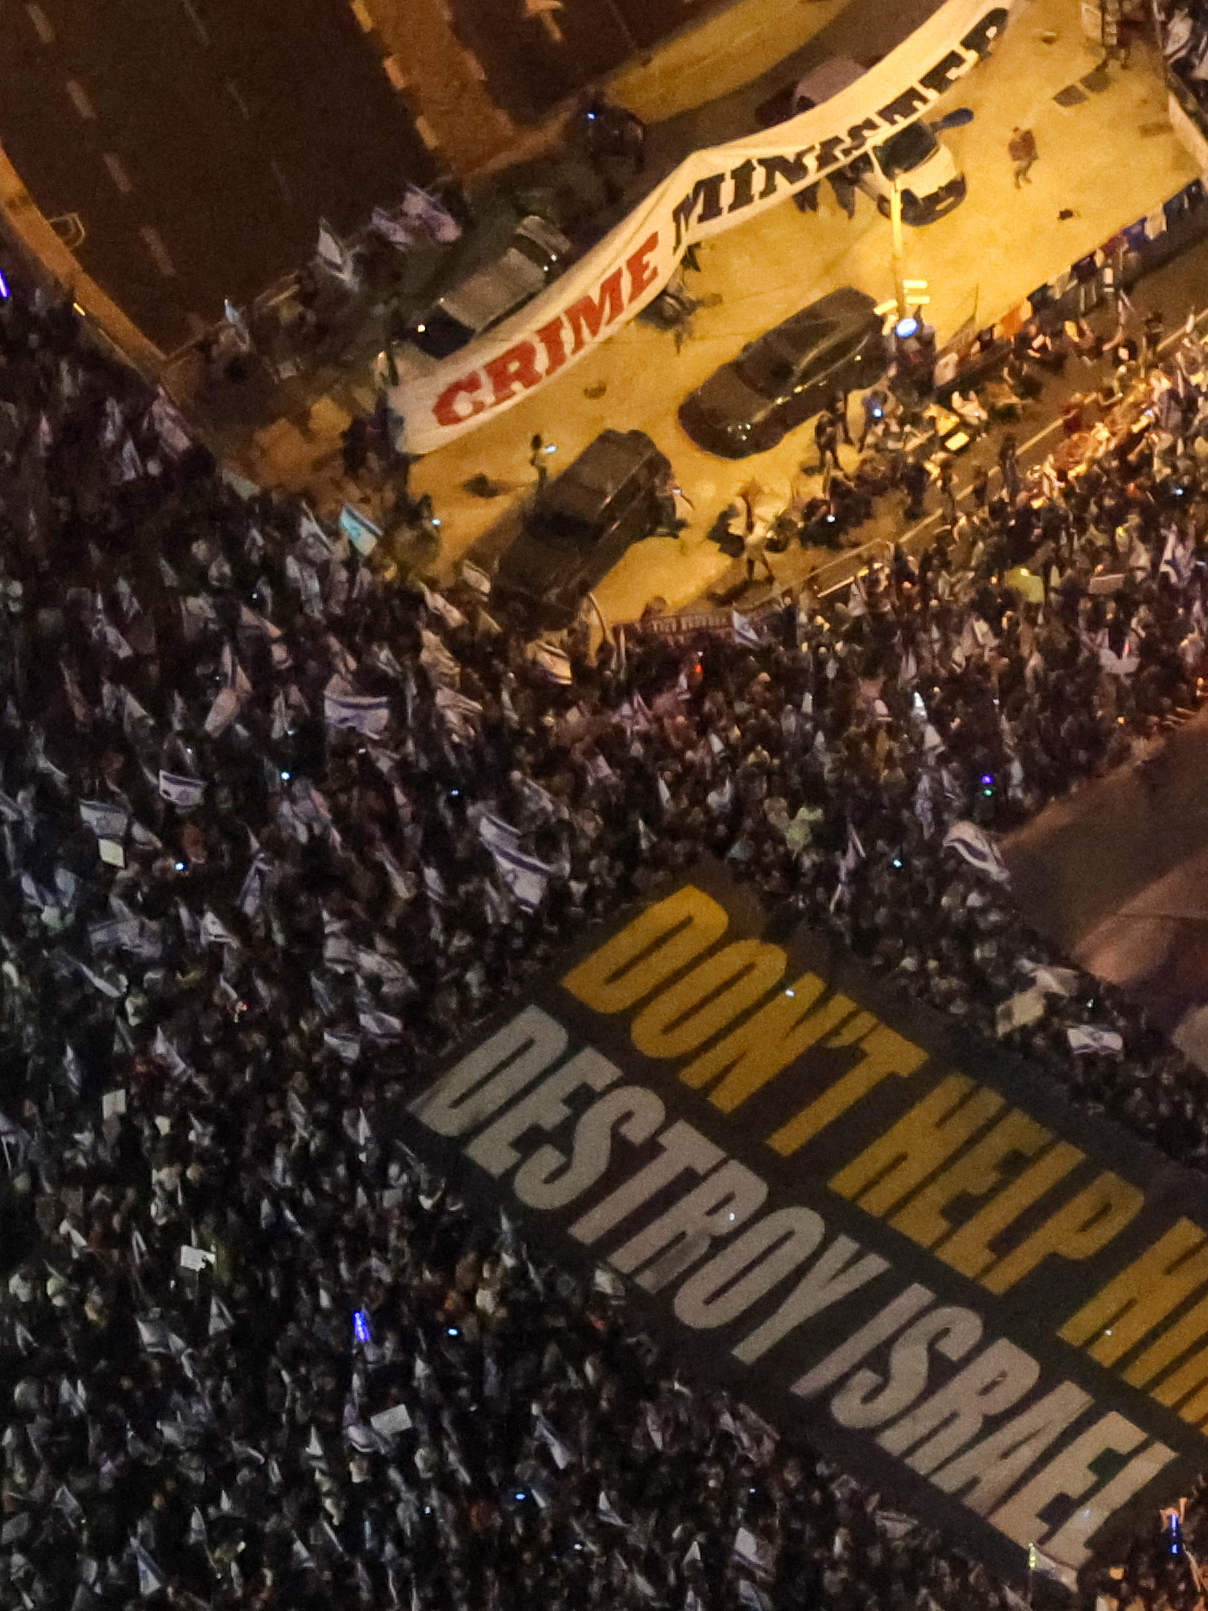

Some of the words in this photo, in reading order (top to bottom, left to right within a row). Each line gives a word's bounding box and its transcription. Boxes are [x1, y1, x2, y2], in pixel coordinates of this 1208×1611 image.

[433, 233, 660, 427] CRIME
[407, 1004, 890, 1366] DESTROY
[790, 1282, 1179, 1571] ISRAEL
[561, 884, 928, 1157] DON'T
[828, 1072, 1146, 1296] HELP
